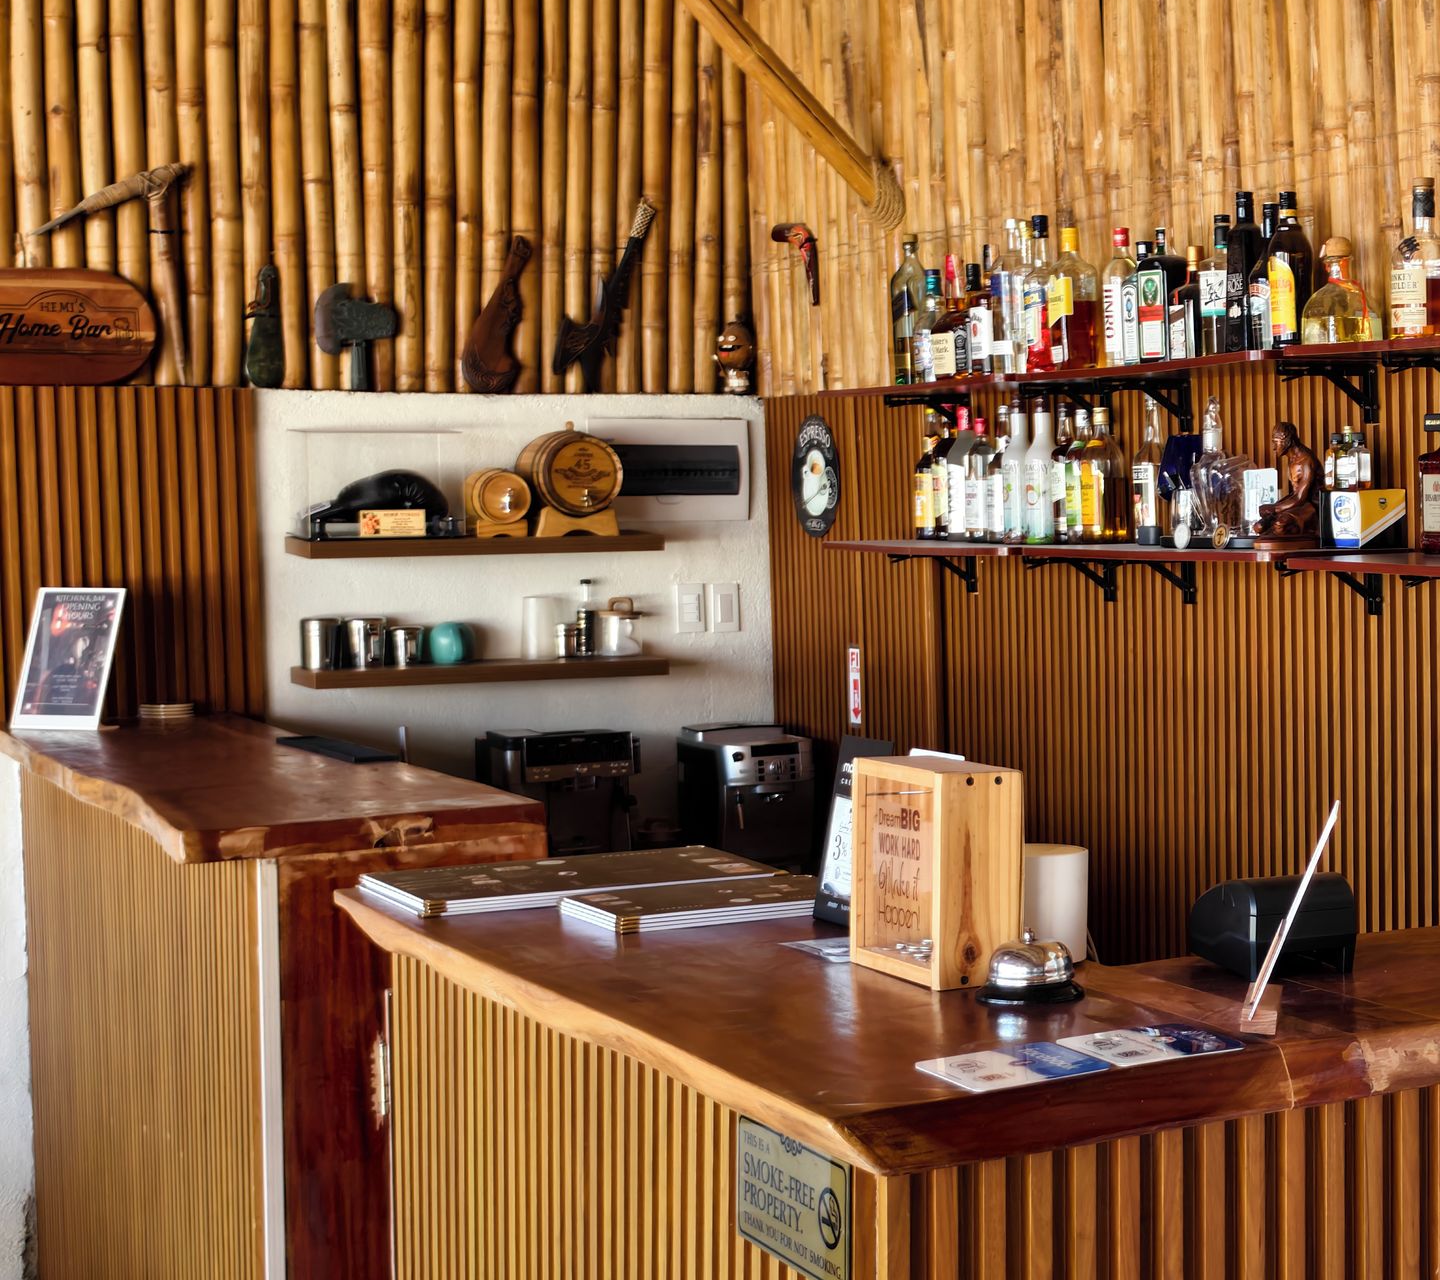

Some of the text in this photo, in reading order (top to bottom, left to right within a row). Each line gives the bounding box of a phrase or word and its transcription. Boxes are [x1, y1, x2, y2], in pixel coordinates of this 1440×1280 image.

[40, 297, 86, 313] HEMI'S
[0, 313, 112, 344] Home Bar
[800, 425, 830, 448] ESPRESSO
[901, 808, 920, 831] BIG
[879, 832, 920, 861] WORK HARD
[744, 1131, 757, 1148] THIS
[744, 1152, 815, 1211] SMOKE-FREE
[744, 1181, 804, 1234] PROPERTY.
[744, 1211, 765, 1234] THANK
[766, 1225, 779, 1242] YOU
[780, 1232, 792, 1250] FOR
[794, 1240, 808, 1259] NOT
